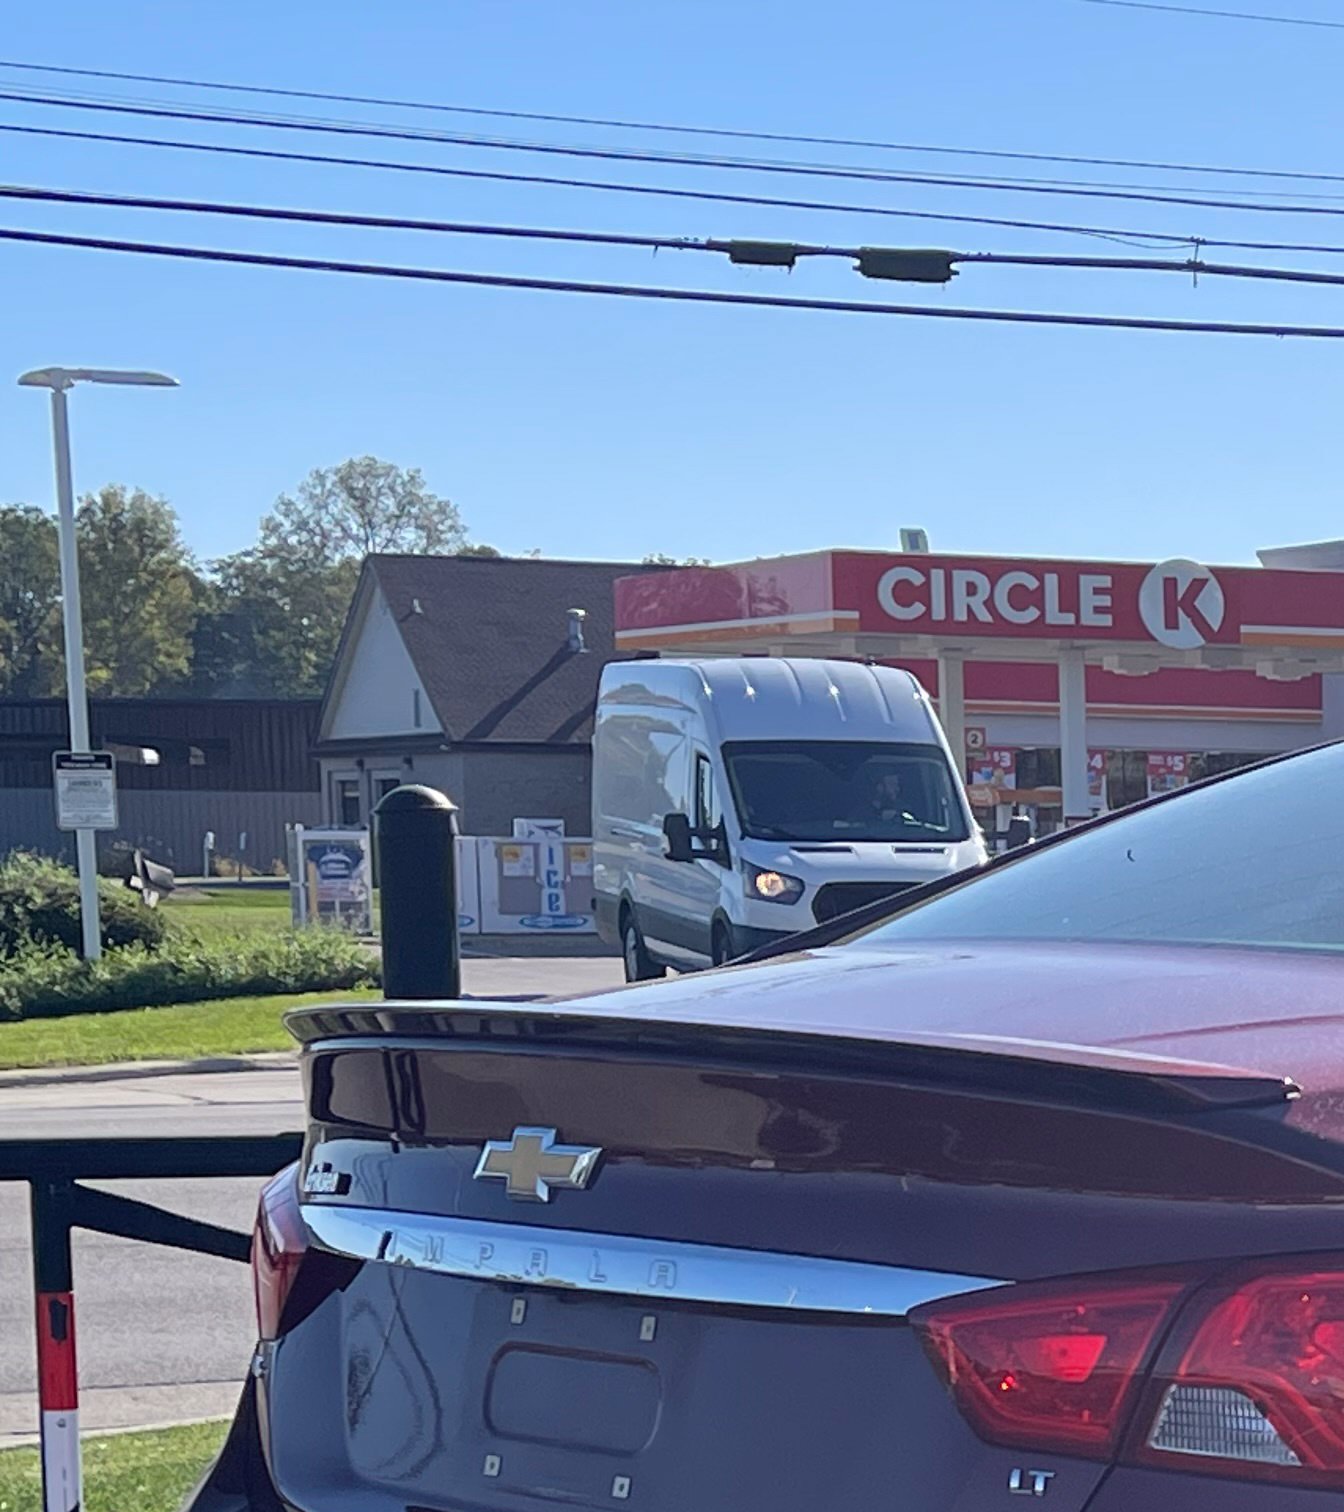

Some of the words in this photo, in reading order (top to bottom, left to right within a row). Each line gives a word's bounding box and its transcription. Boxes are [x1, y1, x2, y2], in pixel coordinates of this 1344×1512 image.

[877, 566, 1113, 627] CIRCLE
[1156, 572, 1218, 646] K
[970, 733, 979, 745] 2
[387, 1230, 679, 1290] IMPALA
[1009, 1468, 1056, 1496] LT
